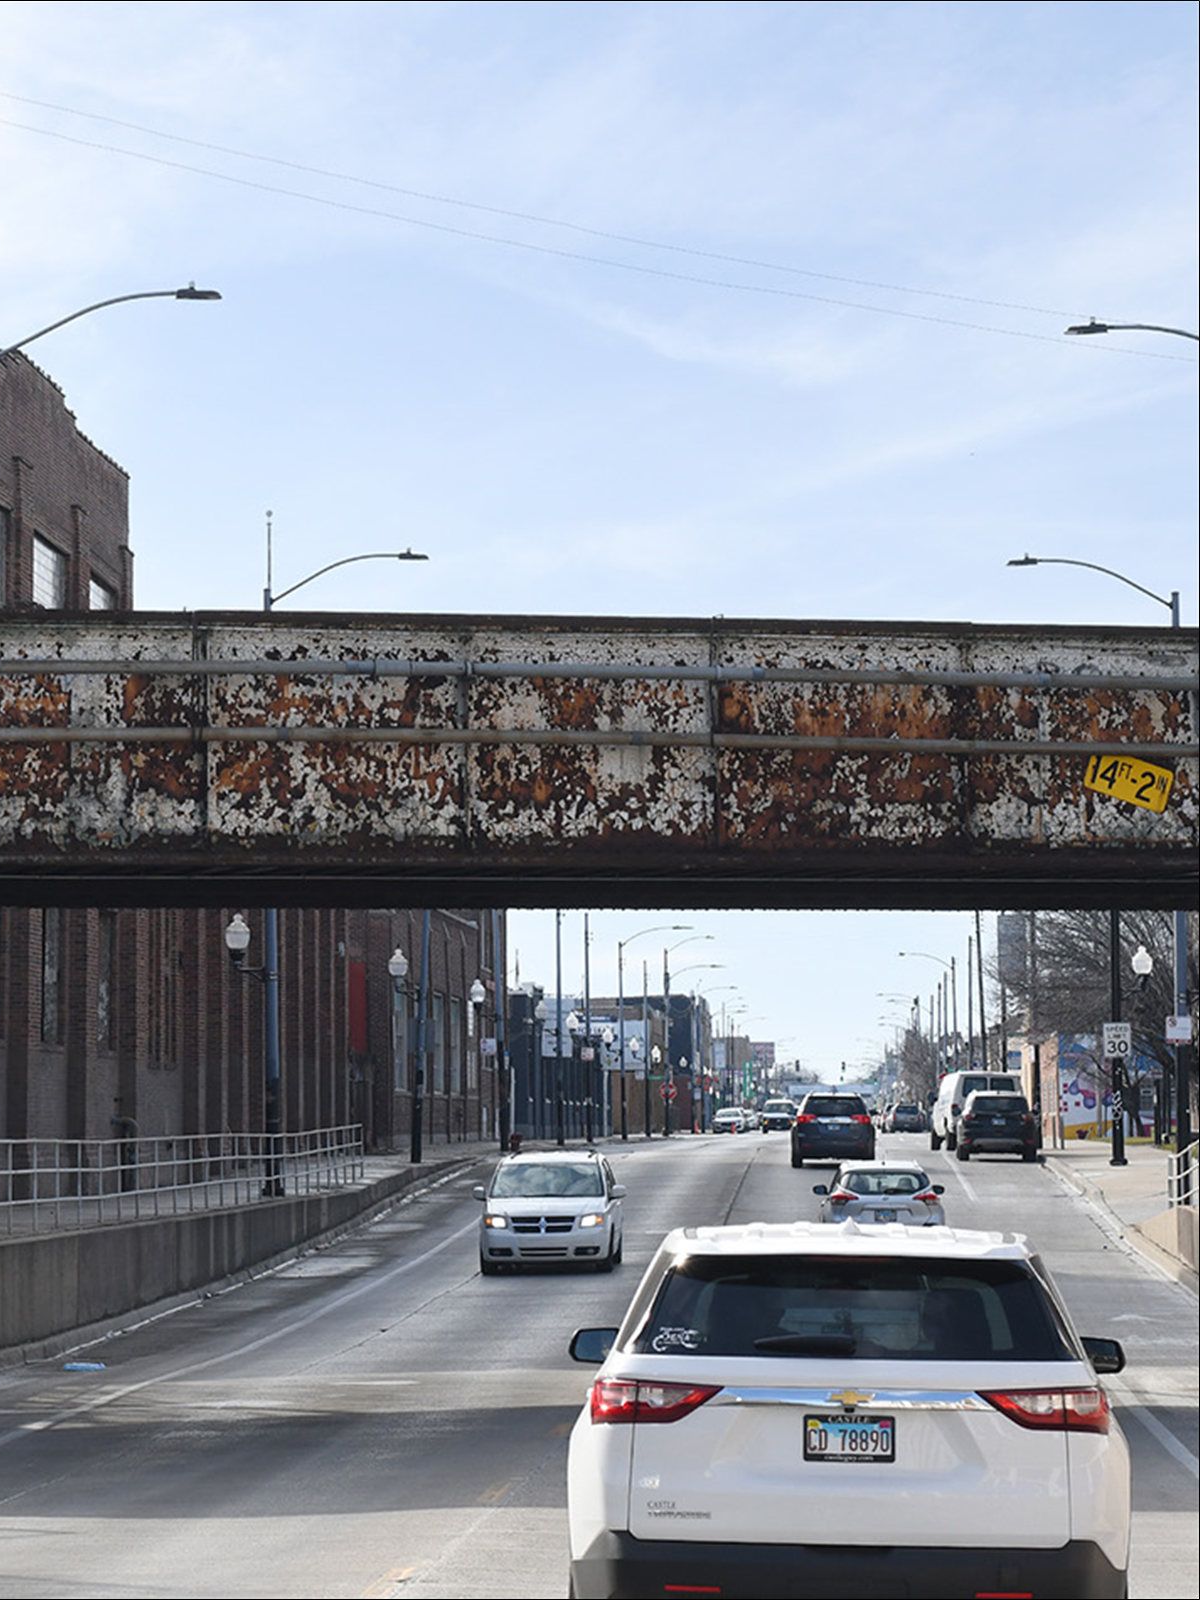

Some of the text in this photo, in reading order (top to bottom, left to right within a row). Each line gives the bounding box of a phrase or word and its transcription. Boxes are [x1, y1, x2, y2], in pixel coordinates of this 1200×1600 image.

[1107, 1040, 1128, 1054] 30
[828, 1416, 870, 1424] CASTLE
[808, 1428, 890, 1452] CD 78890
